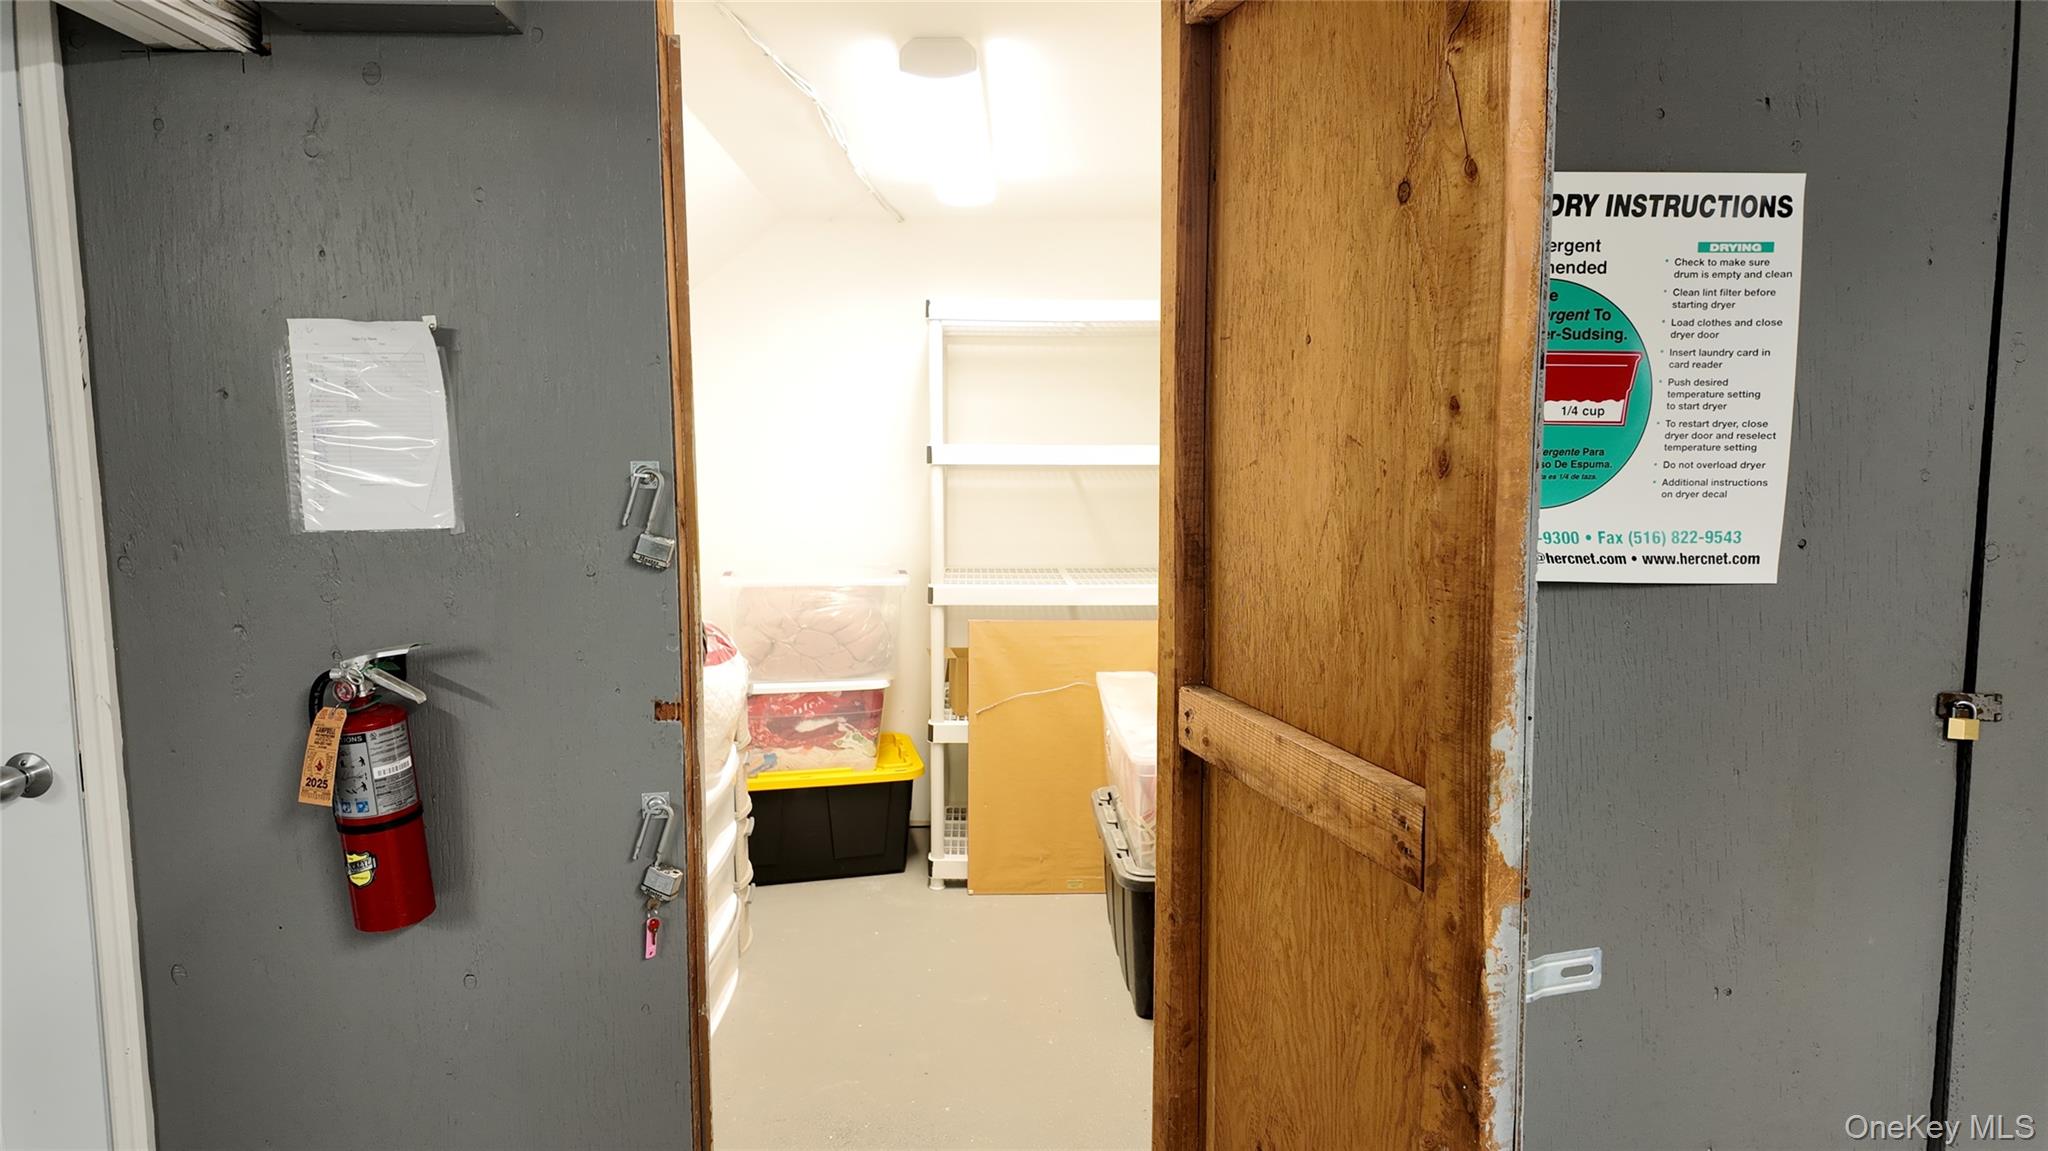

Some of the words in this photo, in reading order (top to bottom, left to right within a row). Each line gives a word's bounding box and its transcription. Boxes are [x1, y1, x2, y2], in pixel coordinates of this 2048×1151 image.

[1605, 194, 1793, 218] INSTRUCTIONS
[1550, 239, 1601, 256] ergent
[1709, 244, 1762, 252] DRYING
[1675, 258, 1704, 267] Check
[1707, 258, 1717, 267] to
[1720, 258, 1746, 267] make
[1749, 259, 1770, 267] sure
[1674, 270, 1698, 279] drum
[1701, 270, 1709, 279] is
[1712, 271, 1741, 280] empty
[1744, 270, 1762, 278] and
[1765, 270, 1792, 278] clean
[1673, 288, 1699, 297] Clean
[1702, 288, 1717, 297] lint
[1720, 288, 1741, 297] filter
[1744, 288, 1776, 297] before
[1672, 301, 1708, 310] starting
[1710, 301, 1735, 310] dryer
[1549, 310, 1589, 324] rgent
[1594, 309, 1611, 321] To
[1671, 319, 1694, 327] Load
[1697, 318, 1732, 327] clothes
[1735, 318, 1752, 327] and
[1755, 318, 1782, 327] close
[1670, 331, 1695, 340] dryer
[1697, 331, 1719, 339] door
[1670, 349, 1695, 357] Insert
[1699, 349, 1734, 359] laundry
[1736, 349, 1758, 357] card
[1762, 349, 1770, 357] in
[1669, 361, 1690, 369] card
[1692, 361, 1722, 369] reader
[1668, 378, 1690, 387] Push
[1693, 378, 1728, 387] desired
[1667, 391, 1724, 400] temperature
[1727, 391, 1761, 400] setting
[1667, 403, 1676, 411] to
[1679, 403, 1699, 411] start
[1702, 402, 1726, 412] dryer
[1561, 406, 1578, 417] 1/4
[1582, 406, 1605, 418] cup
[1666, 420, 1676, 428] To
[1679, 420, 1710, 428] restart
[1712, 420, 1739, 430] dryer,
[1742, 420, 1768, 428] close
[1665, 432, 1688, 441] dryer
[1691, 432, 1713, 440] door
[1716, 432, 1734, 440] and
[1736, 432, 1776, 440] reselect
[1583, 448, 1604, 456] Para
[1664, 444, 1721, 453] temperature
[1724, 444, 1757, 453] setting
[1555, 460, 1567, 468] De
[1571, 460, 1612, 470] Espuma.
[1663, 461, 1676, 469] Do
[1679, 461, 1694, 469] not
[1696, 461, 1737, 469] overload
[1740, 461, 1765, 470] dryer
[1676, 490, 1699, 499] dryer
[1702, 490, 1727, 498] decal
[1598, 532, 1623, 544] Fax
[1628, 531, 1666, 546] (516)
[1671, 531, 1742, 544] 822-9543
[1642, 554, 1760, 565] www.hercnet.com
[305, 777, 329, 789] 2025
